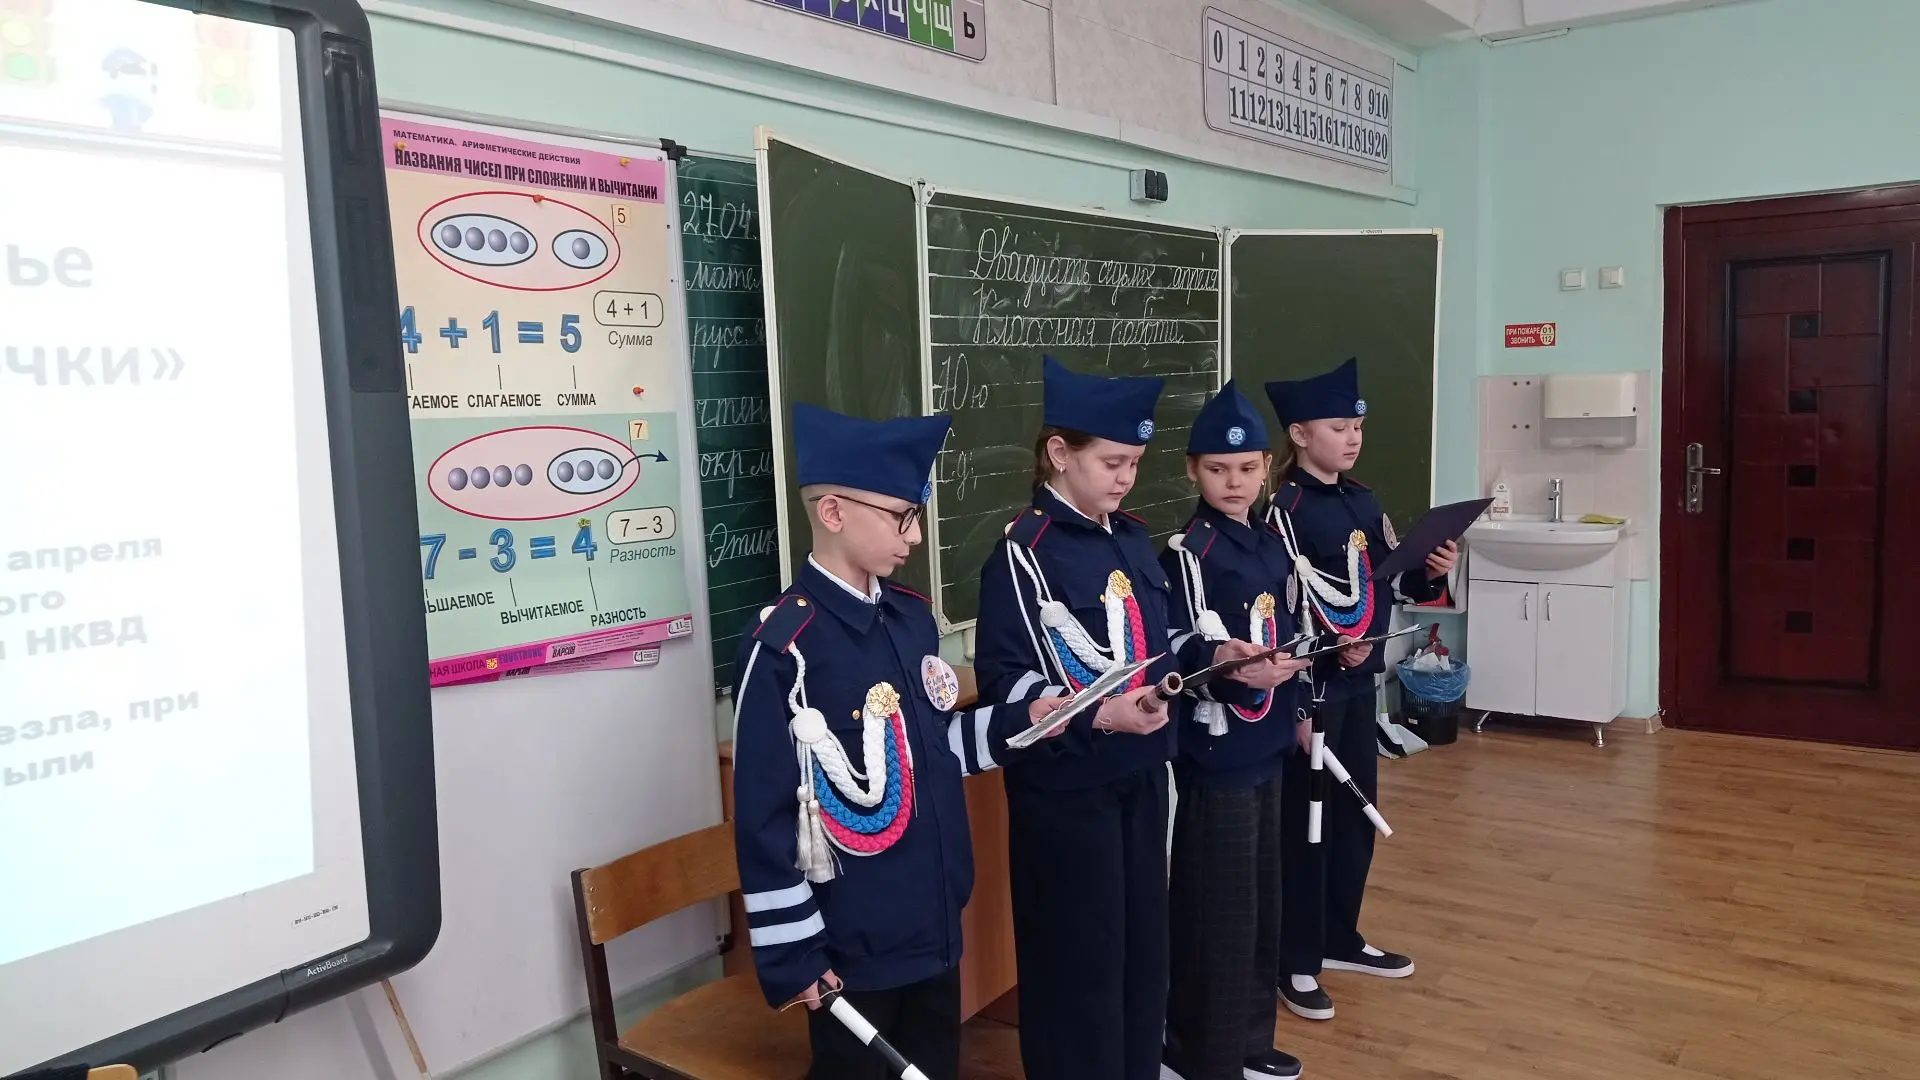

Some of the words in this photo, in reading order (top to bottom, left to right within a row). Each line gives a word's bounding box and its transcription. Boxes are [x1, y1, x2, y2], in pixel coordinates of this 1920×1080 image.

[1213, 30, 1223, 63] 0
[1238, 40, 1247, 72] 1
[1257, 46, 1266, 78] 2
[1275, 53, 1283, 85] 3
[1292, 60, 1300, 90] 4
[1309, 66, 1317, 95] 5
[1325, 72, 1332, 101] 6
[1340, 78, 1347, 106] 7
[1354, 83, 1361, 111] 8
[1368, 88, 1375, 115] 9
[1375, 91, 1388, 120] 10
[1230, 86, 1248, 121] 11
[1249, 92, 1266, 125] 12
[1268, 98, 1283, 130] 13
[1285, 103, 1301, 135] 14
[1302, 109, 1317, 140] 15
[1317, 114, 1332, 144] 16
[1333, 119, 1347, 148] 17
[1347, 123, 1361, 152] 18
[1362, 128, 1375, 155] 19
[1375, 132, 1388, 159] 20
[393, 130, 457, 146] МАТЕМАТИКА.
[462, 140, 537, 159] АРИФМЕТИЧЕСКИЕ
[538, 152, 581, 165] ДЕЙСТВИЯ
[394, 148, 461, 173] НАЗВАНИЯ
[464, 158, 502, 179] ЧИСЕЛ
[504, 165, 525, 182] ПРИ
[528, 168, 588, 190] СЛОЖЕНИИ
[589, 177, 597, 191] И
[598, 178, 658, 200] ВЫЧИТАНИИ
[617, 207, 626, 224] 5
[606, 299, 617, 318] 4
[640, 301, 649, 319] 1
[400, 305, 422, 353] 4
[482, 310, 502, 353] 1
[560, 313, 582, 354] 5
[607, 330, 653, 349] Сумма
[1518, 327, 1540, 335] ПОЖАРЕ
[1542, 335, 1552, 343] 112
[0, 345, 185, 388] чки»
[408, 395, 459, 409] АЕМОЕ
[467, 394, 541, 409] СЛАГАЕМОЕ
[557, 393, 596, 407] СУММА
[634, 422, 643, 438] 7
[620, 518, 631, 538] 7
[653, 515, 663, 534] 3
[7, 538, 162, 573] апреля
[420, 533, 446, 580] 7
[489, 528, 517, 574] 3
[571, 525, 598, 562] 4
[609, 544, 677, 563] Разность
[425, 592, 495, 613] ЬШАЕМОЕ
[500, 599, 584, 625] ВЫЧИТАЕМОЕ
[590, 606, 647, 627] РАЗНОСТЬ
[26, 615, 148, 656] НКВД
[451, 660, 486, 674] ШКОЛА
[129, 691, 199, 722] при
[307, 954, 348, 977] ActivBoard
